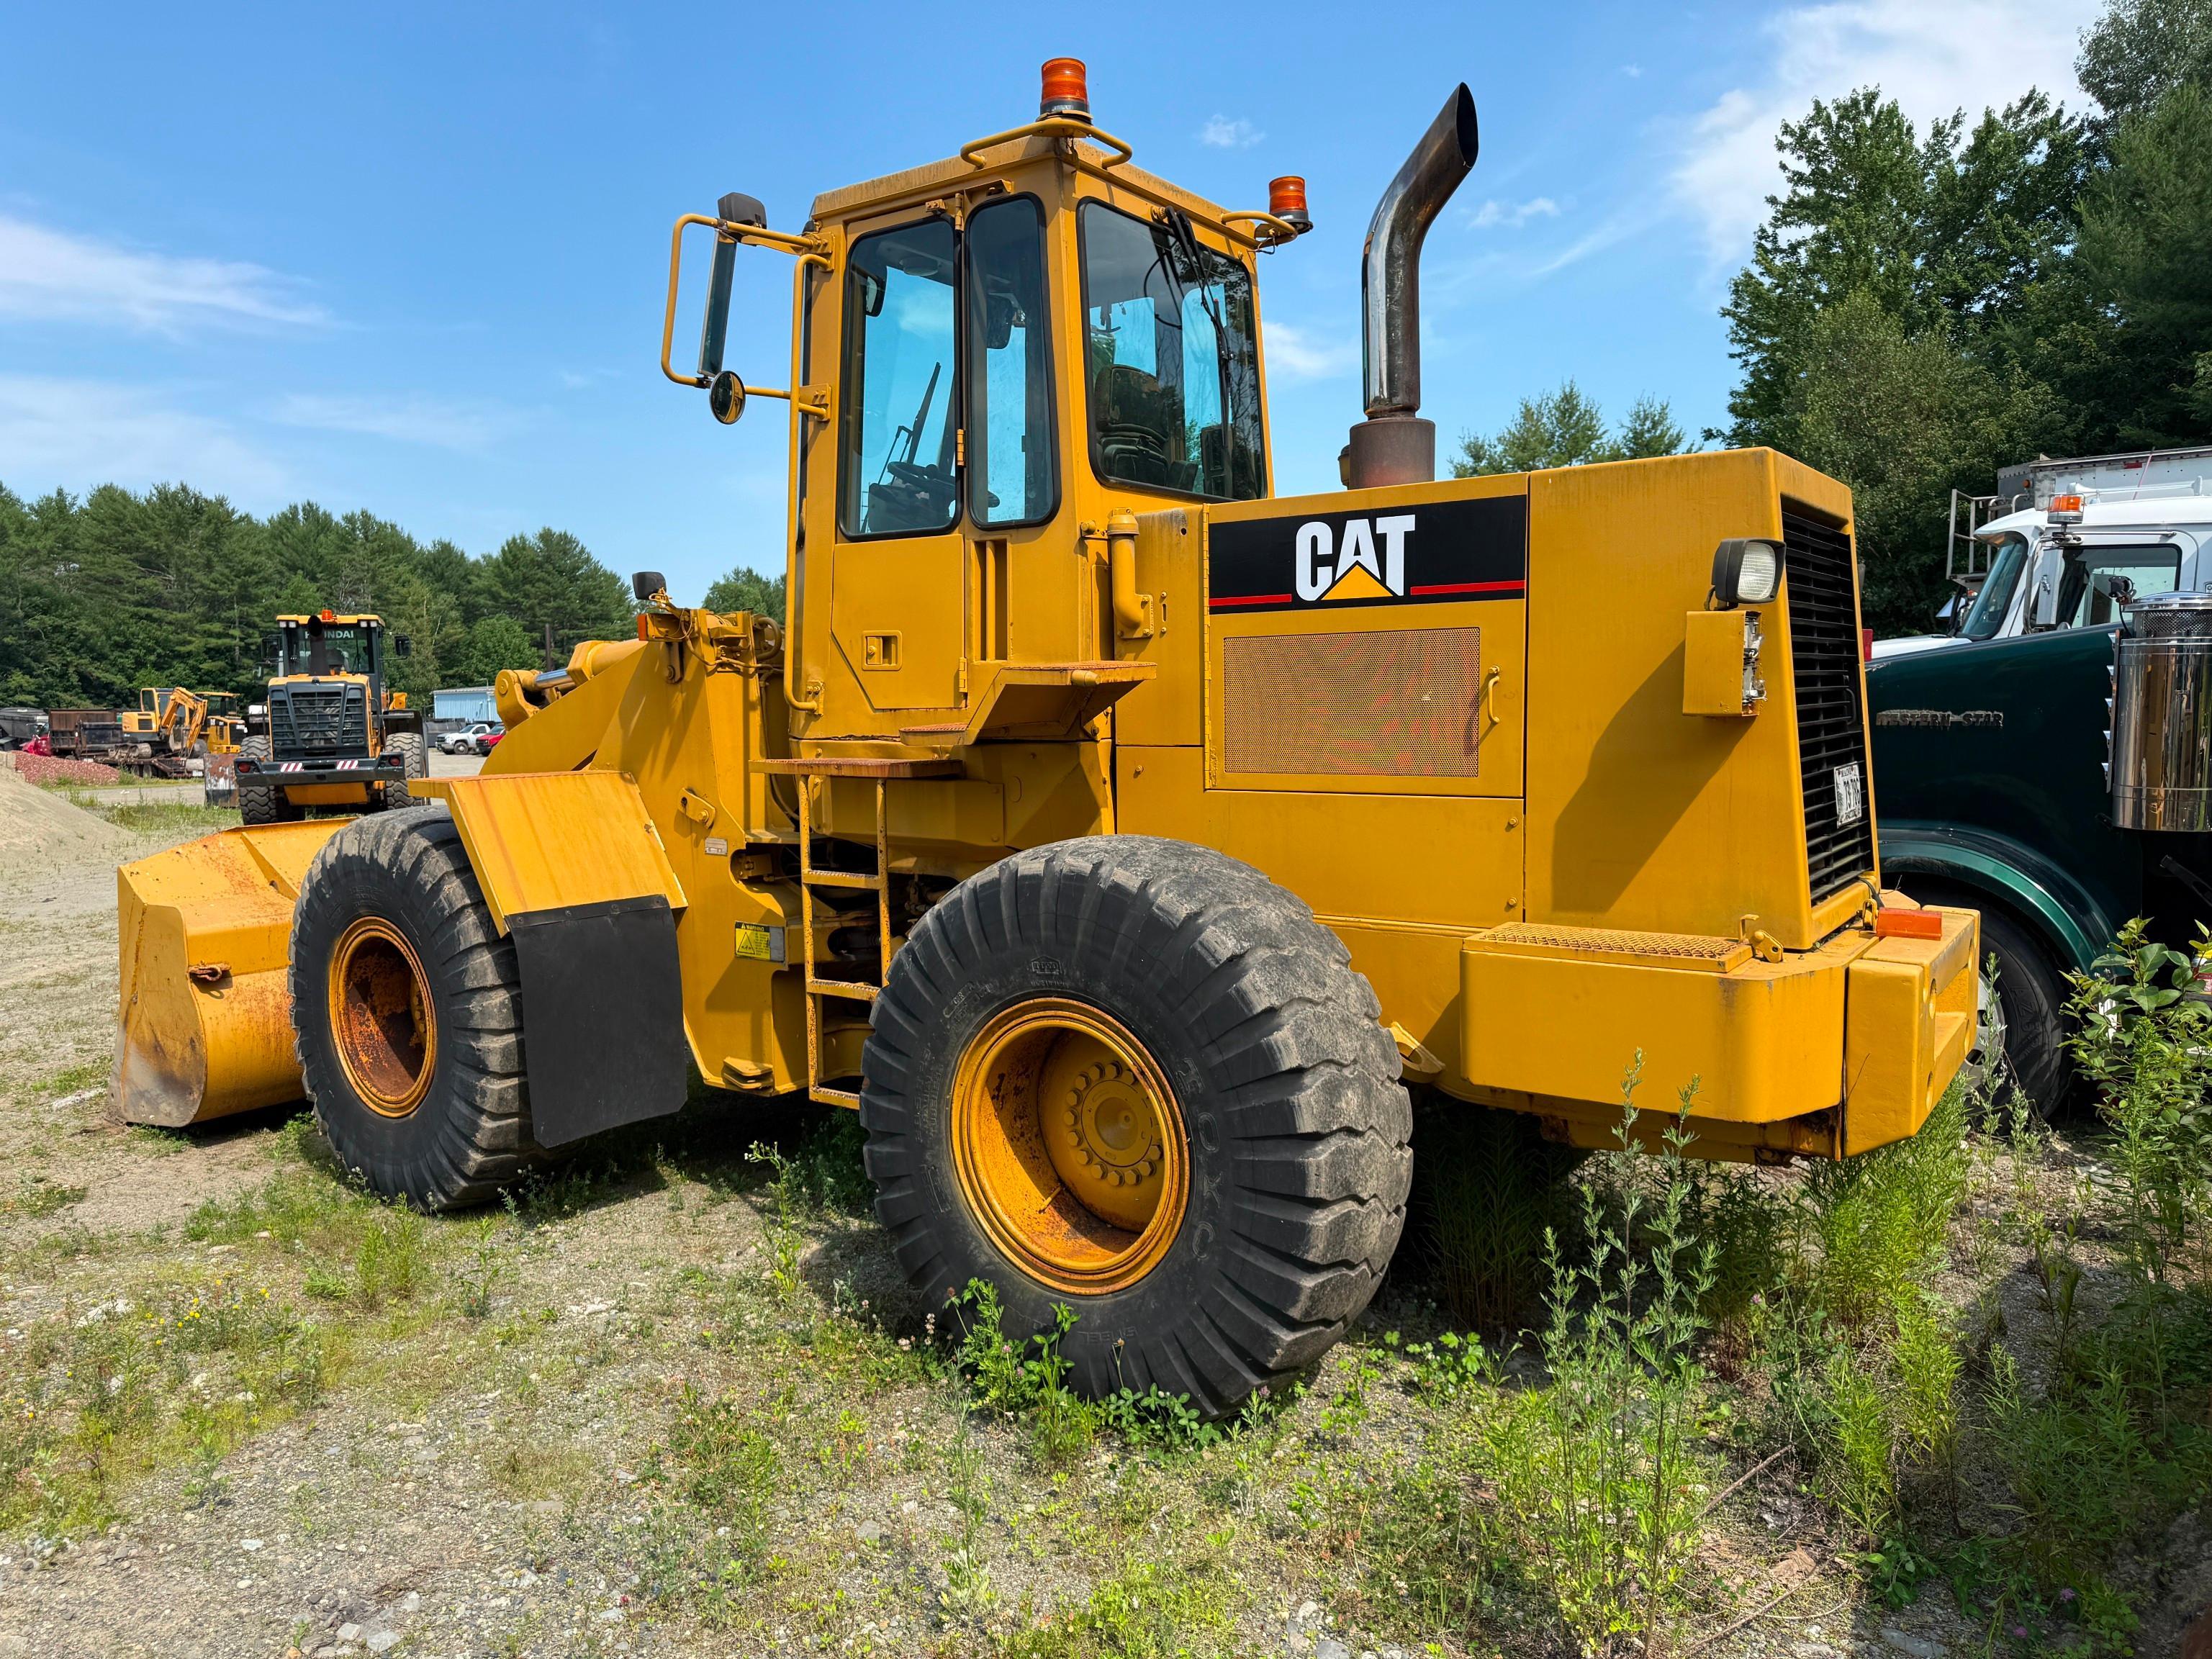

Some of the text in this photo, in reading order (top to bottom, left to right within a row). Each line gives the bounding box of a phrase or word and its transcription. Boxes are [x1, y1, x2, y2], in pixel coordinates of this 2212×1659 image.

[1295, 514, 1416, 602] CAT
[304, 630, 354, 639] HNDAI
[1876, 712, 2003, 727] WESTERN STAR
